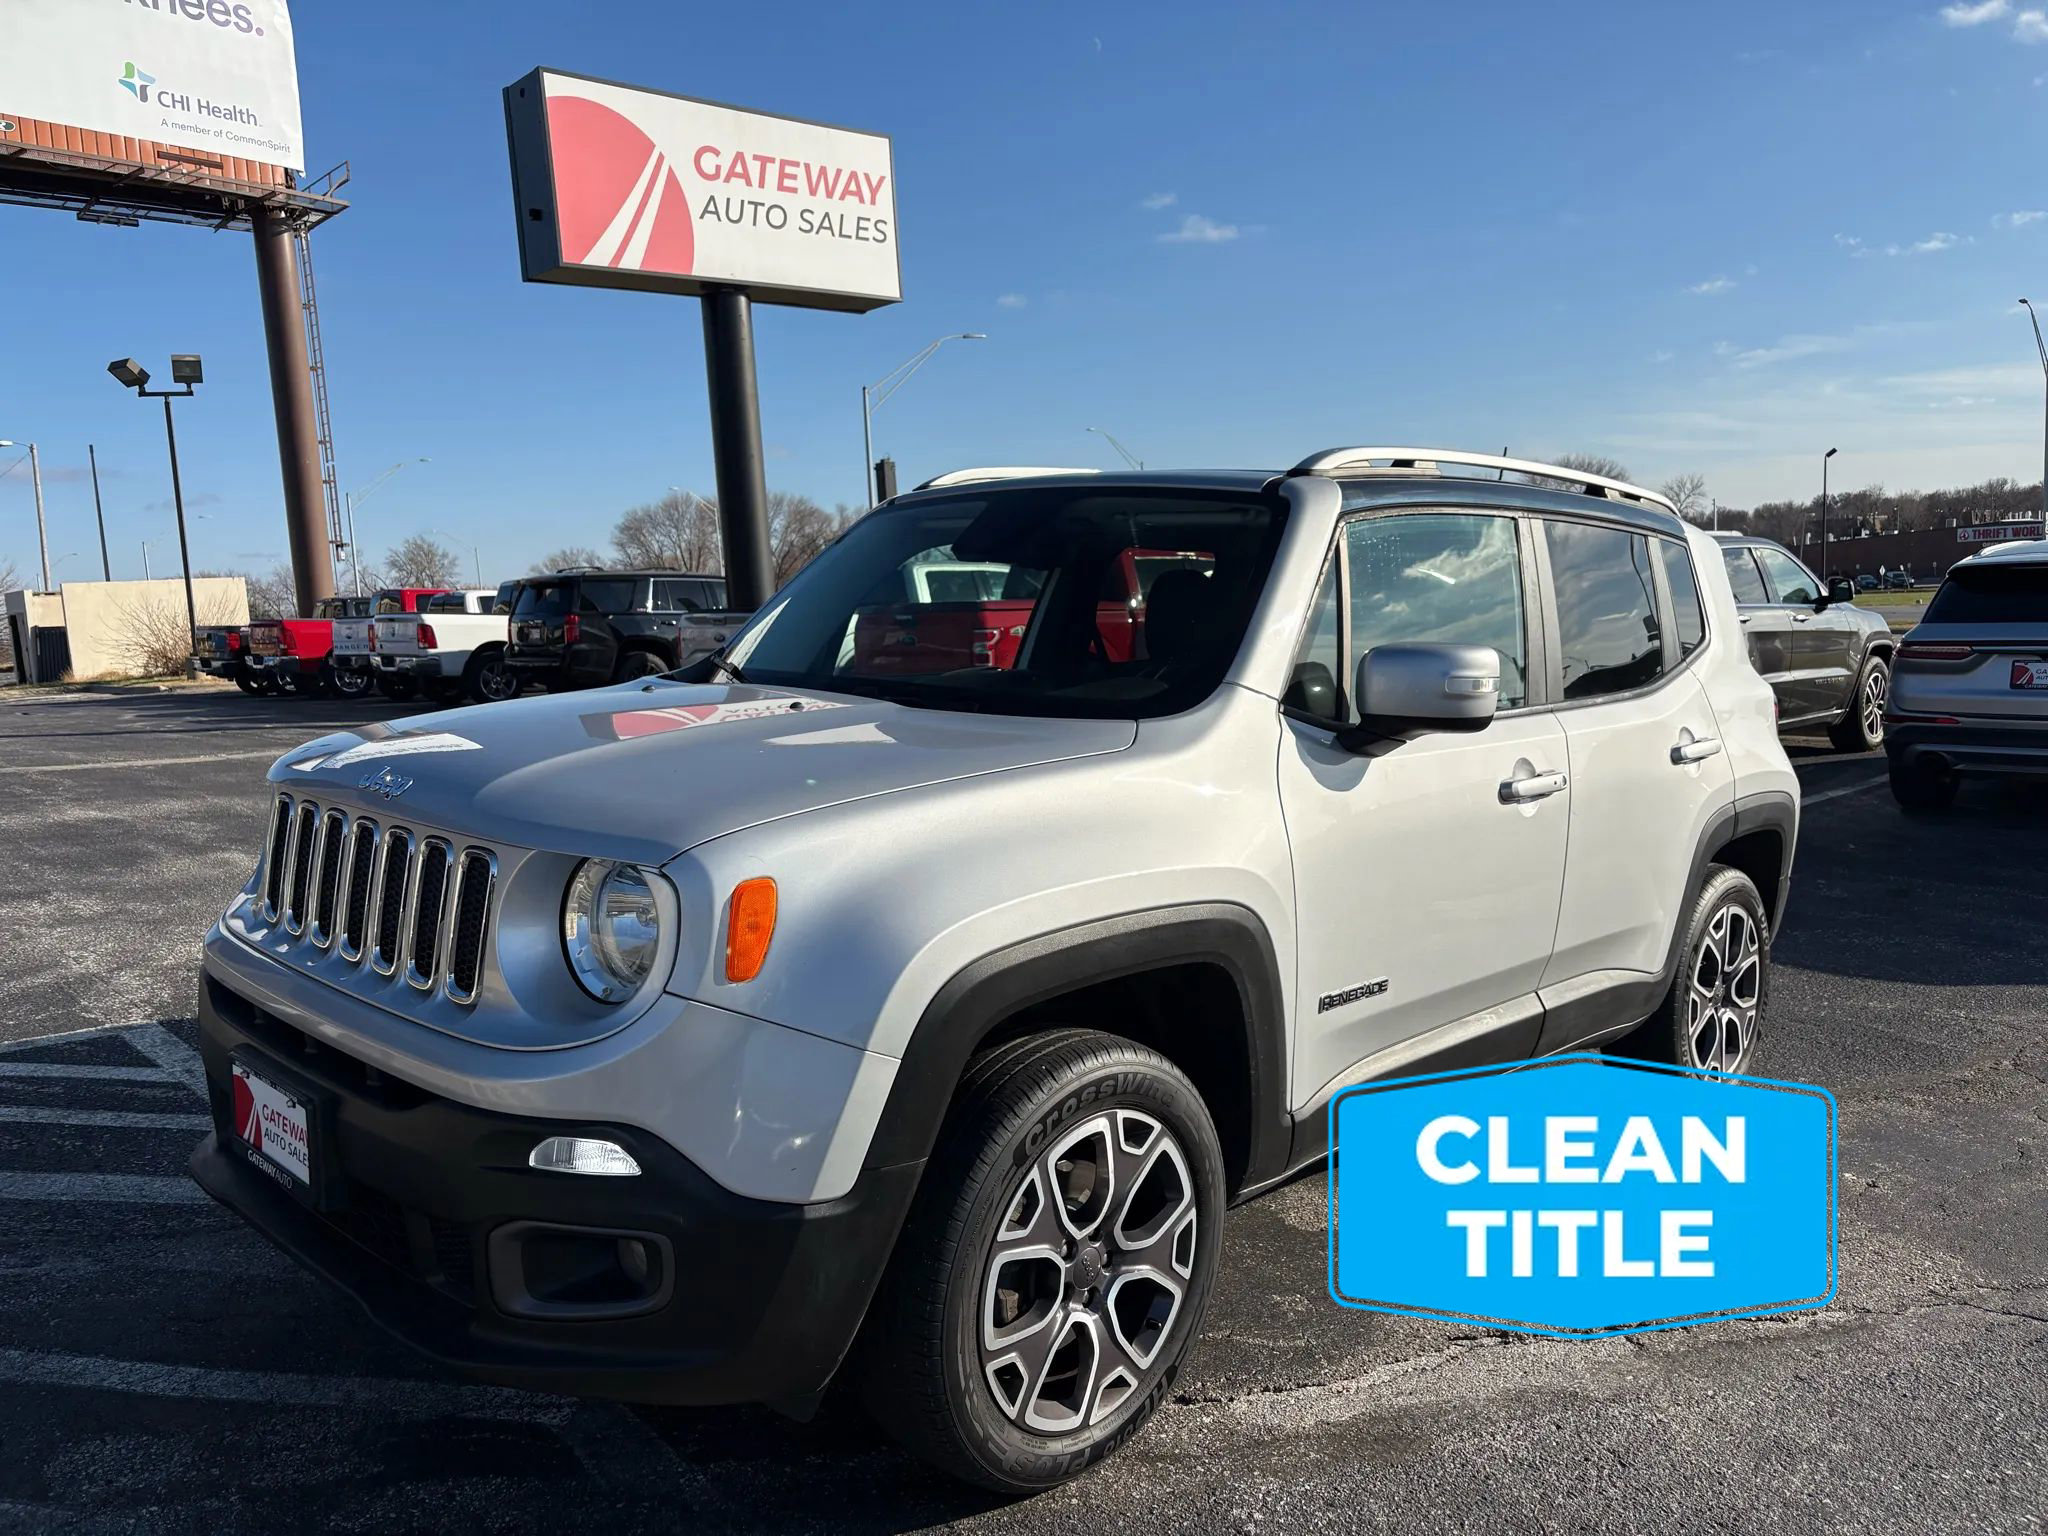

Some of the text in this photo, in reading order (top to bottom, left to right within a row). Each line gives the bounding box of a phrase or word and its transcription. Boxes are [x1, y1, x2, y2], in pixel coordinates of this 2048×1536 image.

[157, 90, 258, 126] CHI Health
[160, 118, 291, 153] A member of CommonSpirit
[693, 144, 886, 206] GATEWAY
[699, 194, 888, 243] AUTO SALES
[1972, 526, 2043, 539] THRIFT WORL
[358, 766, 414, 800] Jeep
[262, 1103, 309, 1148] GATEWAY
[263, 1127, 287, 1151] AUTO
